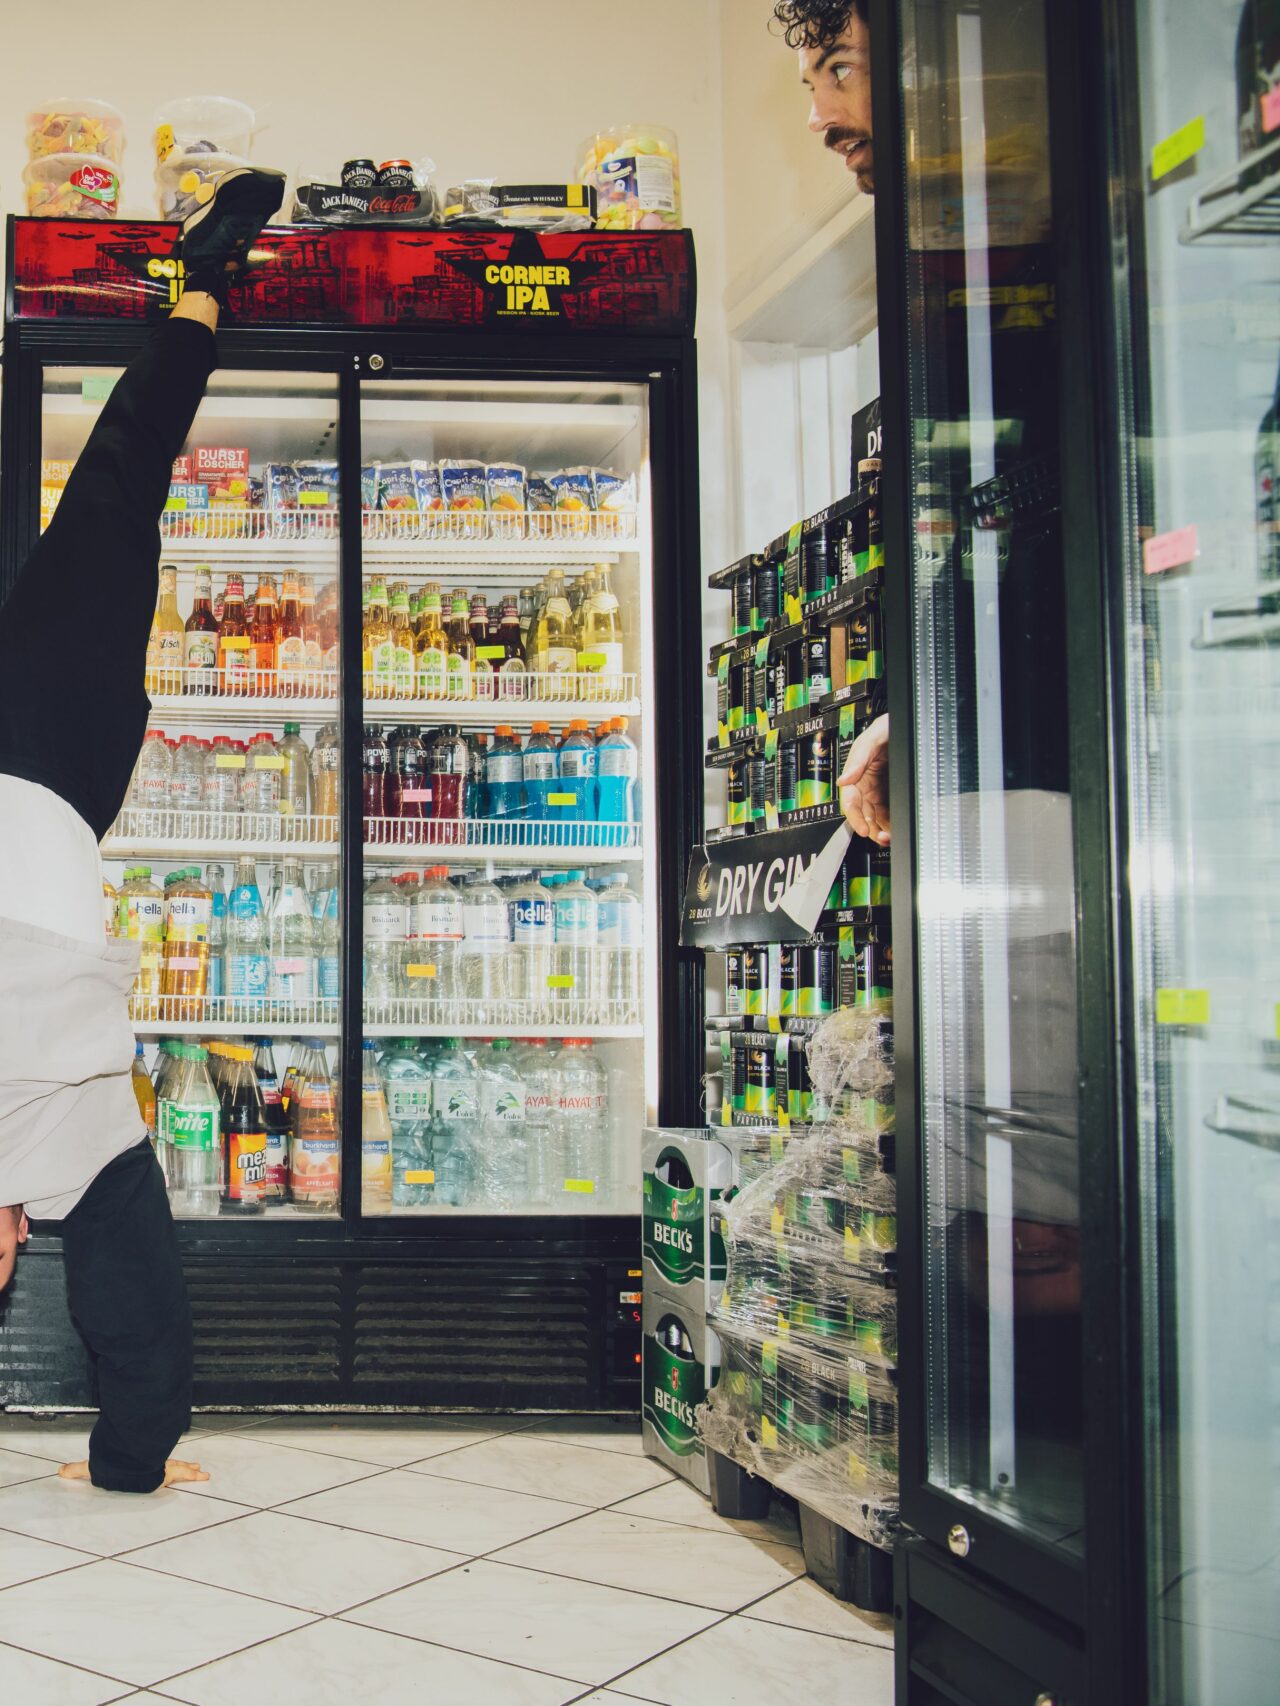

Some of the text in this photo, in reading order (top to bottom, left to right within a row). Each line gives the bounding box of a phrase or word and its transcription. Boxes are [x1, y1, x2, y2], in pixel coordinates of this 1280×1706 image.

[321, 196, 340, 209] JACK
[486, 264, 570, 286] CORNER
[506, 286, 550, 310] IPA
[198, 449, 244, 461] DURST
[802, 508, 828, 534] 28 BLACK
[796, 717, 824, 736] 28 BLACK
[788, 803, 834, 823] PARTYBOX
[716, 861, 764, 918] DRY
[514, 900, 553, 924] hella
[688, 907, 712, 919] 28 BLACK
[304, 1140, 337, 1150] burkhardt
[654, 1220, 693, 1254] BECK'S
[811, 1362, 836, 1380] BLACK
[654, 1386, 694, 1429] BECK'S
